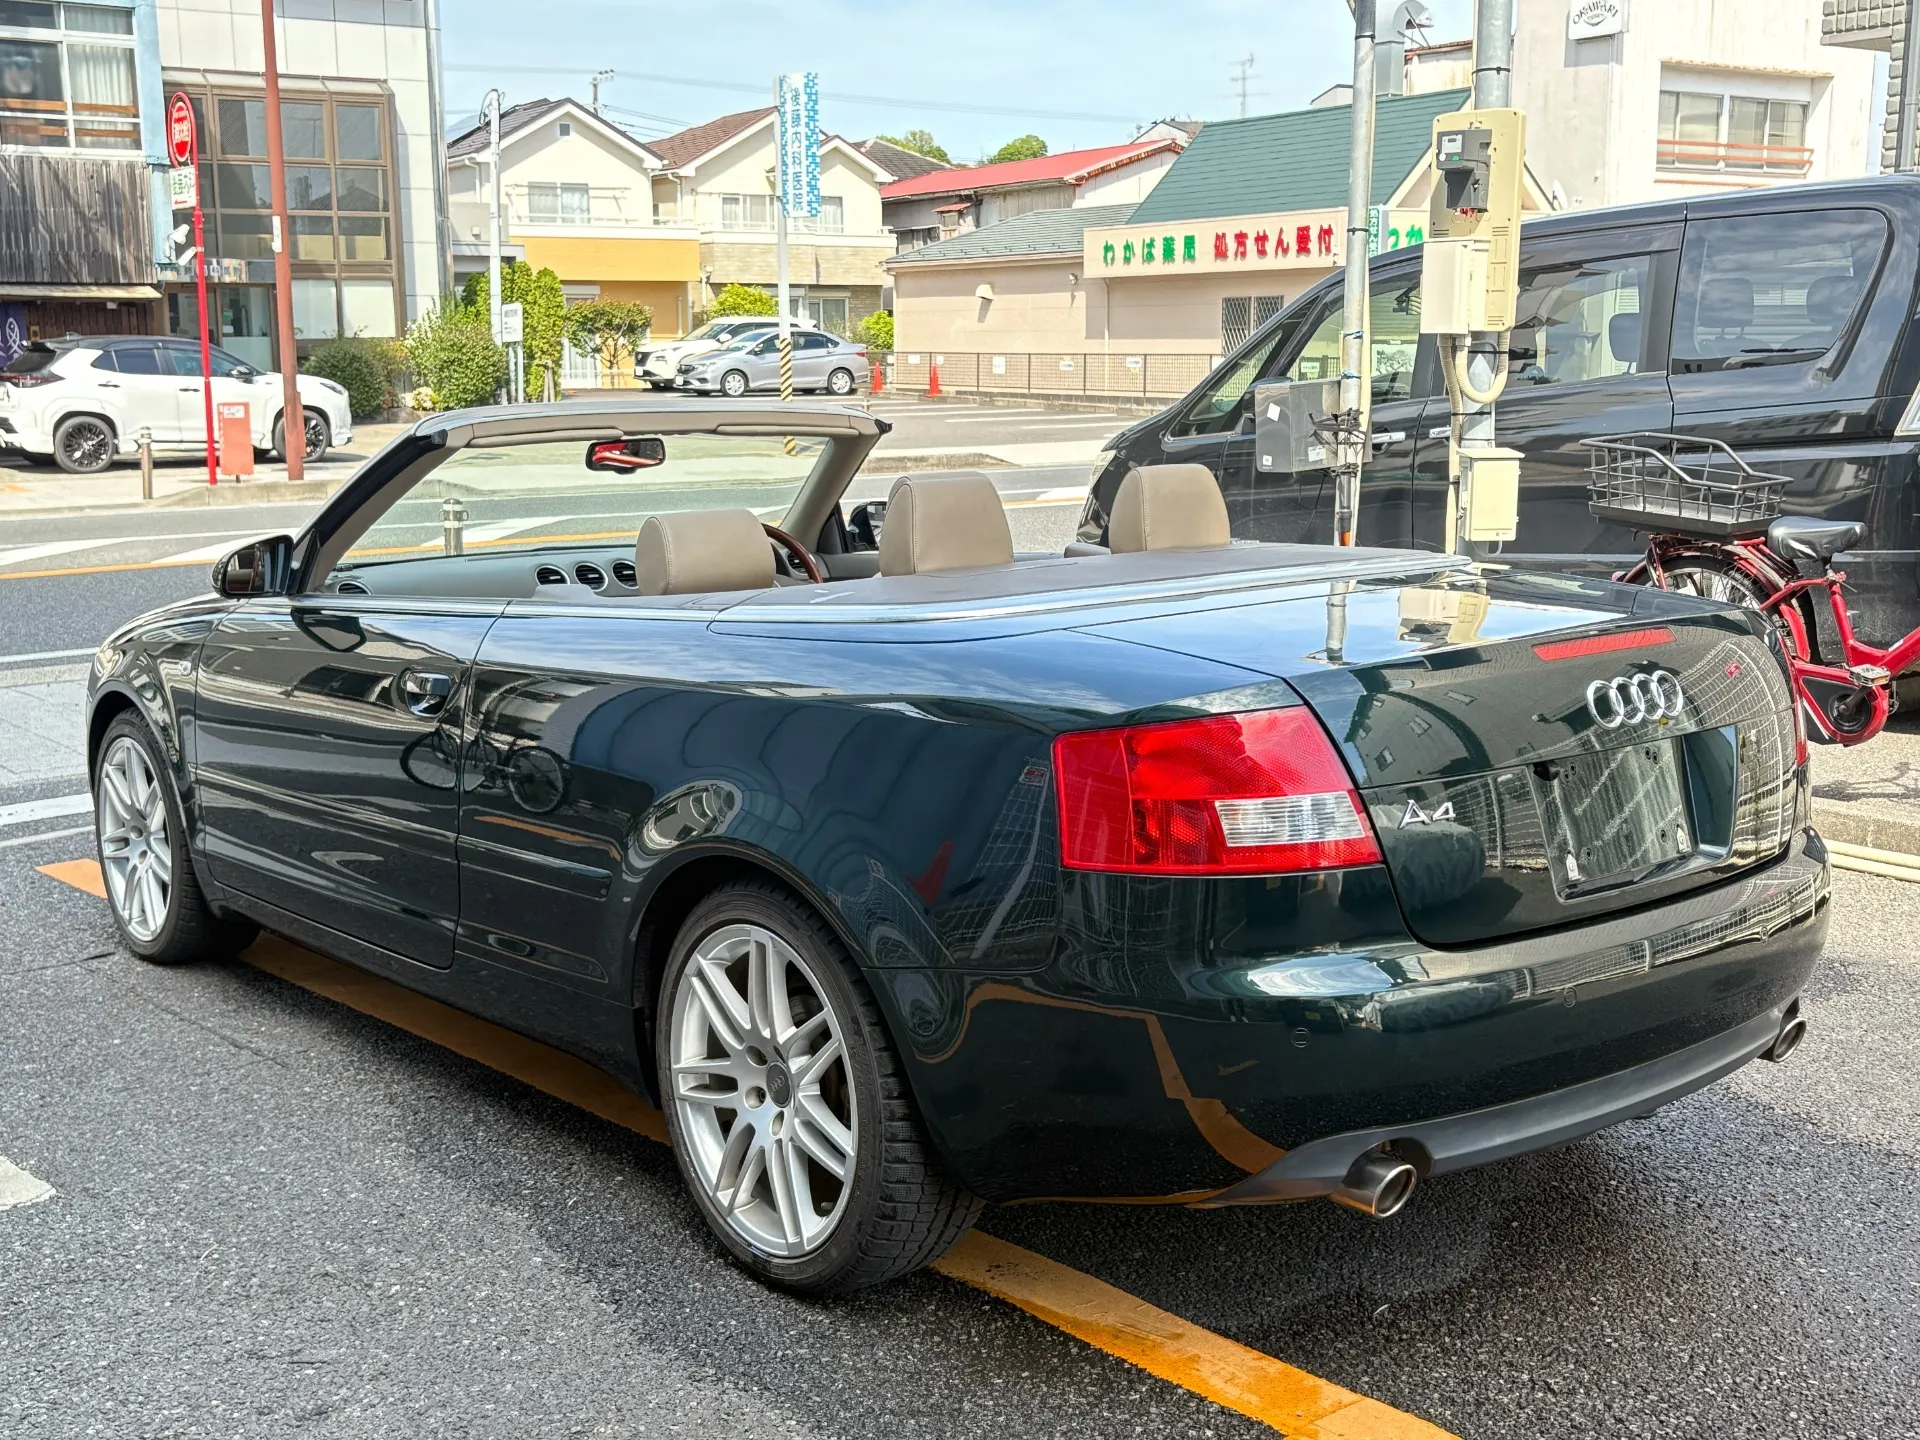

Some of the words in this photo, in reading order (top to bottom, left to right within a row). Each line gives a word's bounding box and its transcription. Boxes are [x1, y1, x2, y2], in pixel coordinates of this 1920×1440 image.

[1103, 234, 1197, 267] わかば薬局
[1214, 223, 1335, 262] 処方せん受付
[1397, 799, 1456, 830] A4
